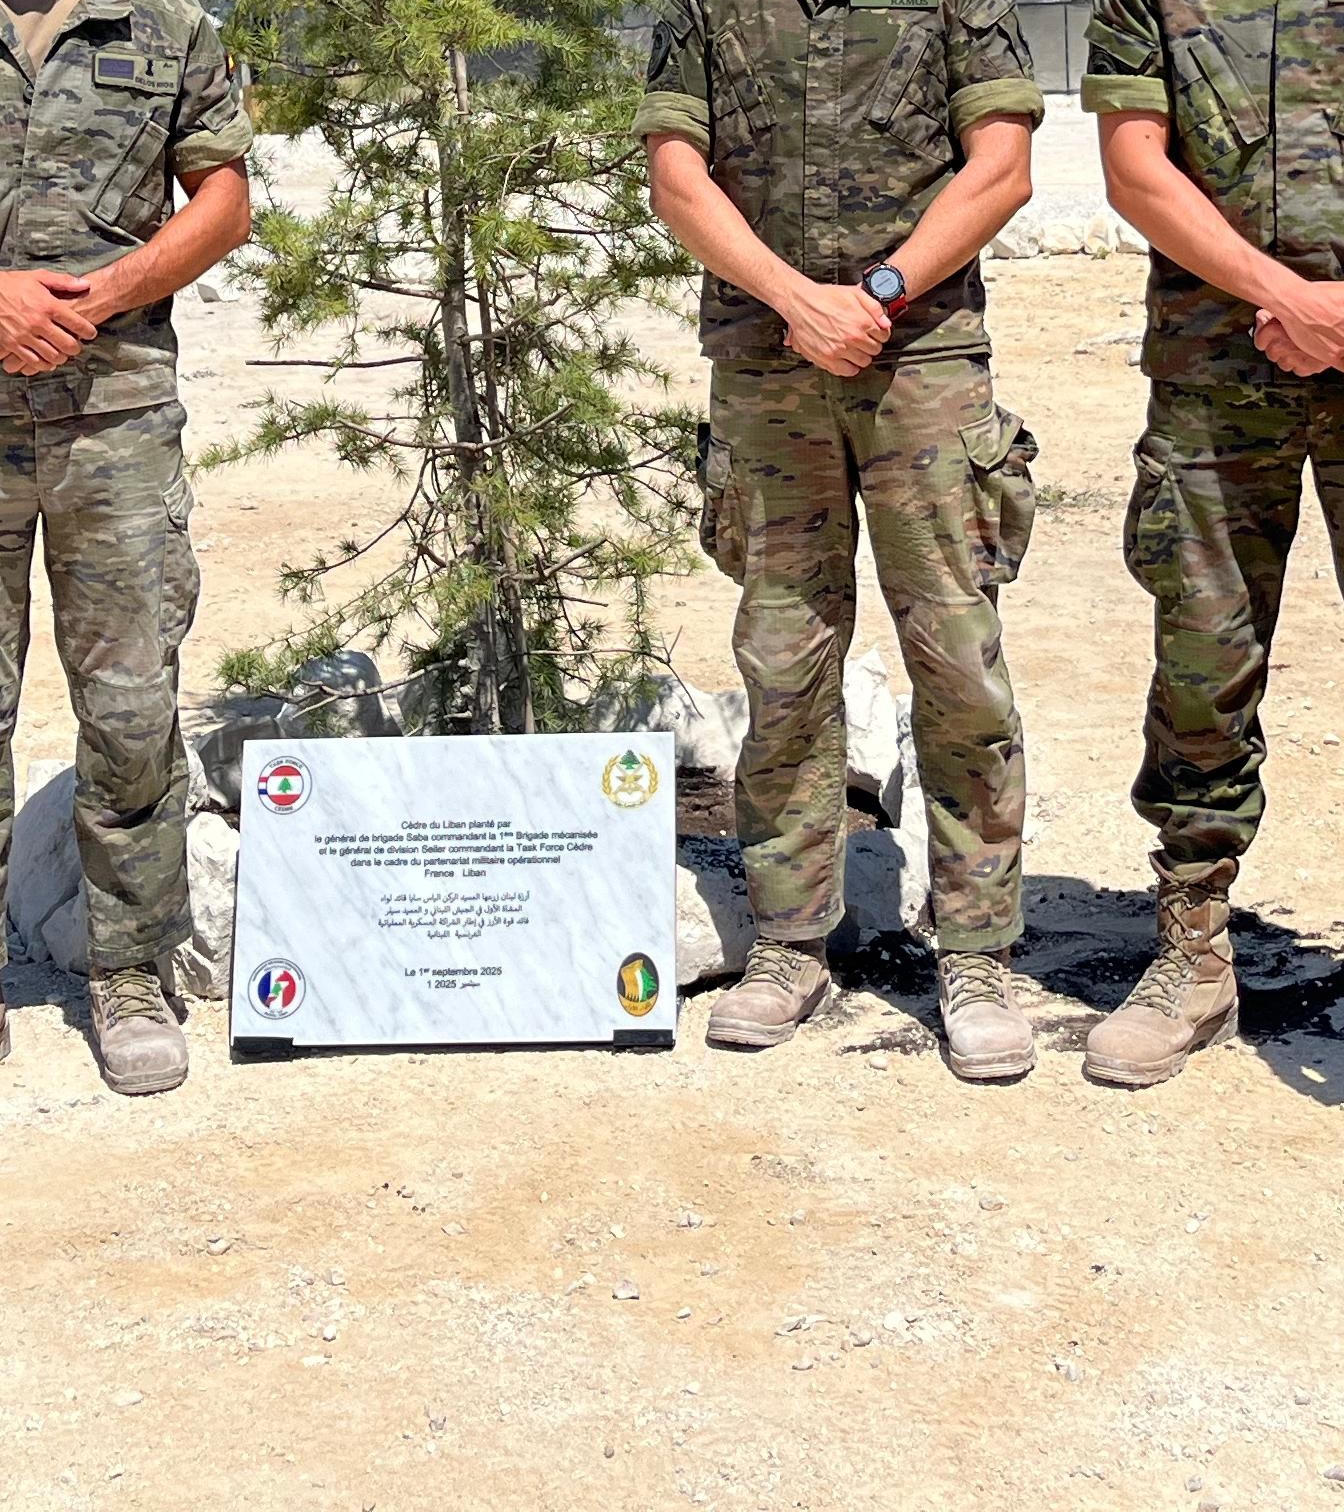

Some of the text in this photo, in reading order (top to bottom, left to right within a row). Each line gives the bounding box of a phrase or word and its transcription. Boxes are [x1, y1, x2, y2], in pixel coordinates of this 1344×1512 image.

[401, 819, 512, 830] Cèdre du Liban planté par
[315, 834, 322, 843] le
[325, 834, 356, 845] général
[359, 834, 369, 842] de
[372, 833, 404, 844] brigade
[431, 832, 487, 842] commandant
[489, 832, 496, 840] la
[516, 831, 549, 842] Brigade
[551, 829, 598, 840] mécanisée
[318, 847, 327, 855] et
[329, 847, 336, 855] le
[339, 846, 371, 857] général
[374, 846, 384, 854] de
[387, 845, 419, 854] division
[448, 843, 504, 853] commandant
[506, 843, 514, 852] la
[516, 843, 537, 852] Task
[540, 842, 565, 852] Force
[566, 841, 593, 851] Cèdre
[350, 854, 561, 867] dans le cadre du partenariat militaire opérationnel
[424, 868, 487, 878] France Liban
[404, 968, 416, 977] Le
[431, 967, 478, 978] septembre
[479, 966, 503, 976] 2025
[434, 979, 457, 989] 2025
